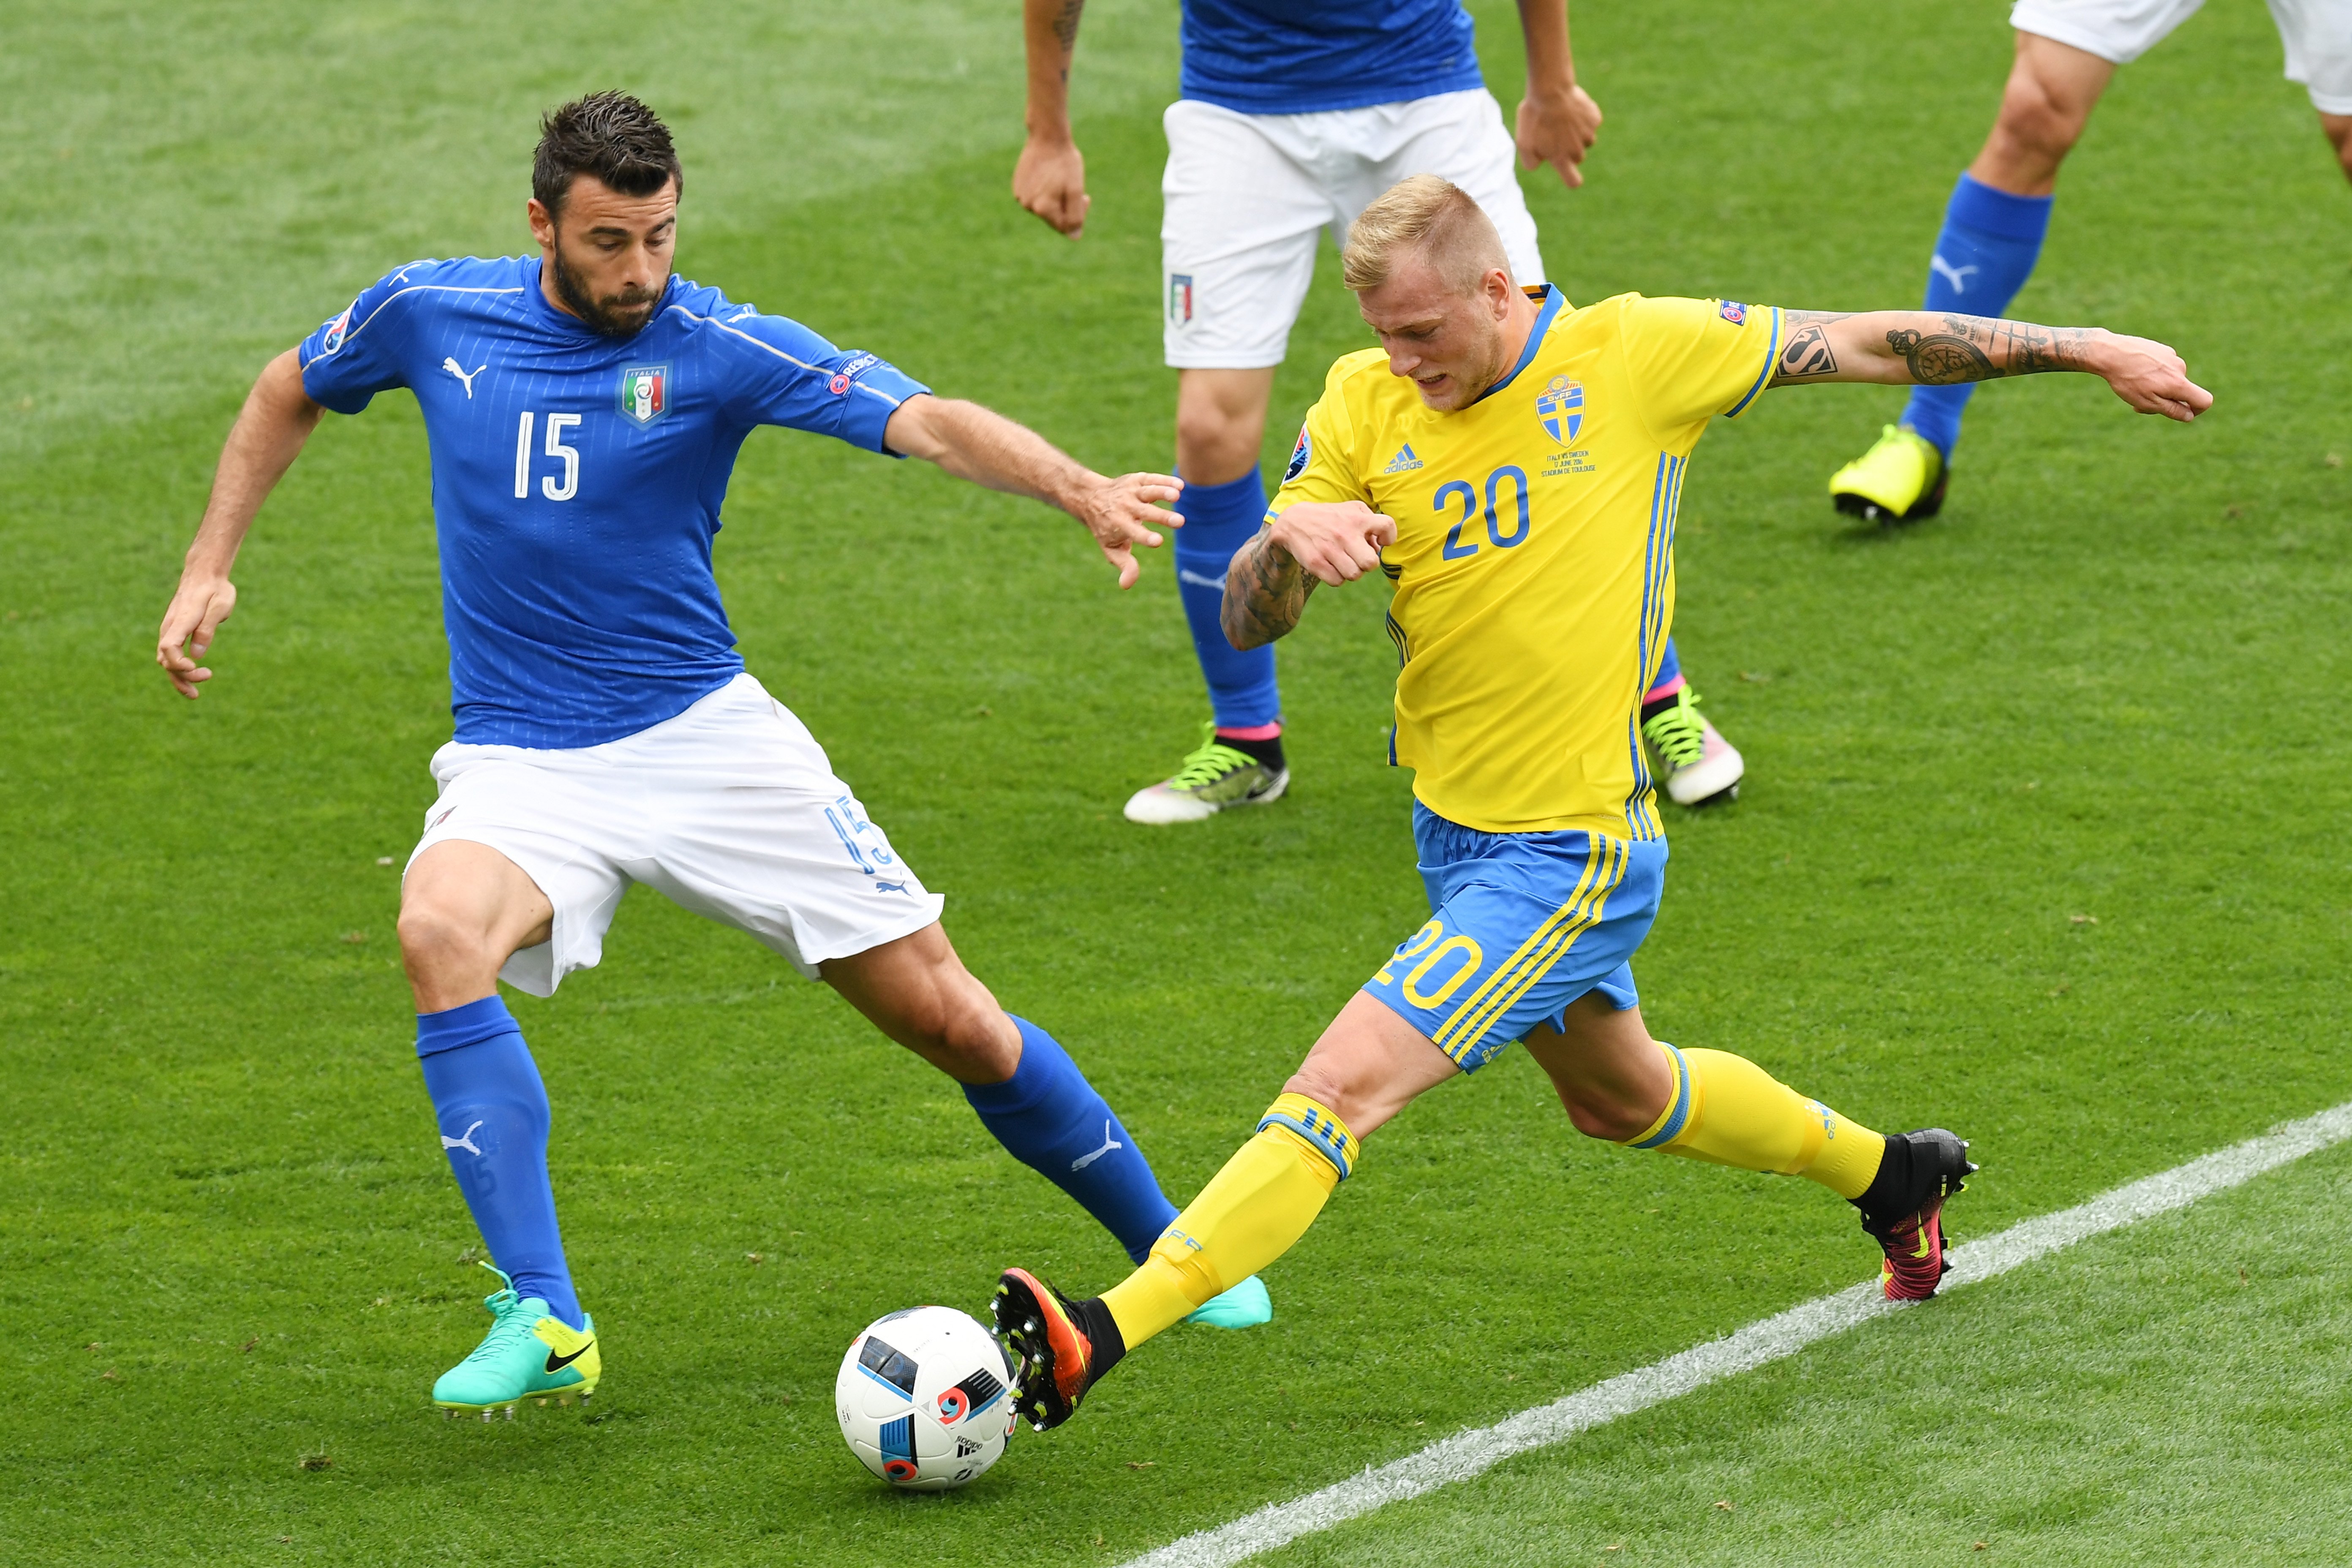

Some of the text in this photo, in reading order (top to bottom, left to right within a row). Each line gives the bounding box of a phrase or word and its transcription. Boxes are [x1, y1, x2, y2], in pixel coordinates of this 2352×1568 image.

[514, 411, 582, 501] 15
[1384, 460, 1424, 474] adidas
[1541, 469, 1563, 477] STADIUM
[1572, 465, 1595, 473] TOULOUSE
[1569, 450, 1589, 458] SWEDEN
[1433, 465, 1530, 561] 20
[825, 795, 892, 874] 15
[1372, 920, 1482, 1009] 20
[955, 1435, 983, 1450] adidas
